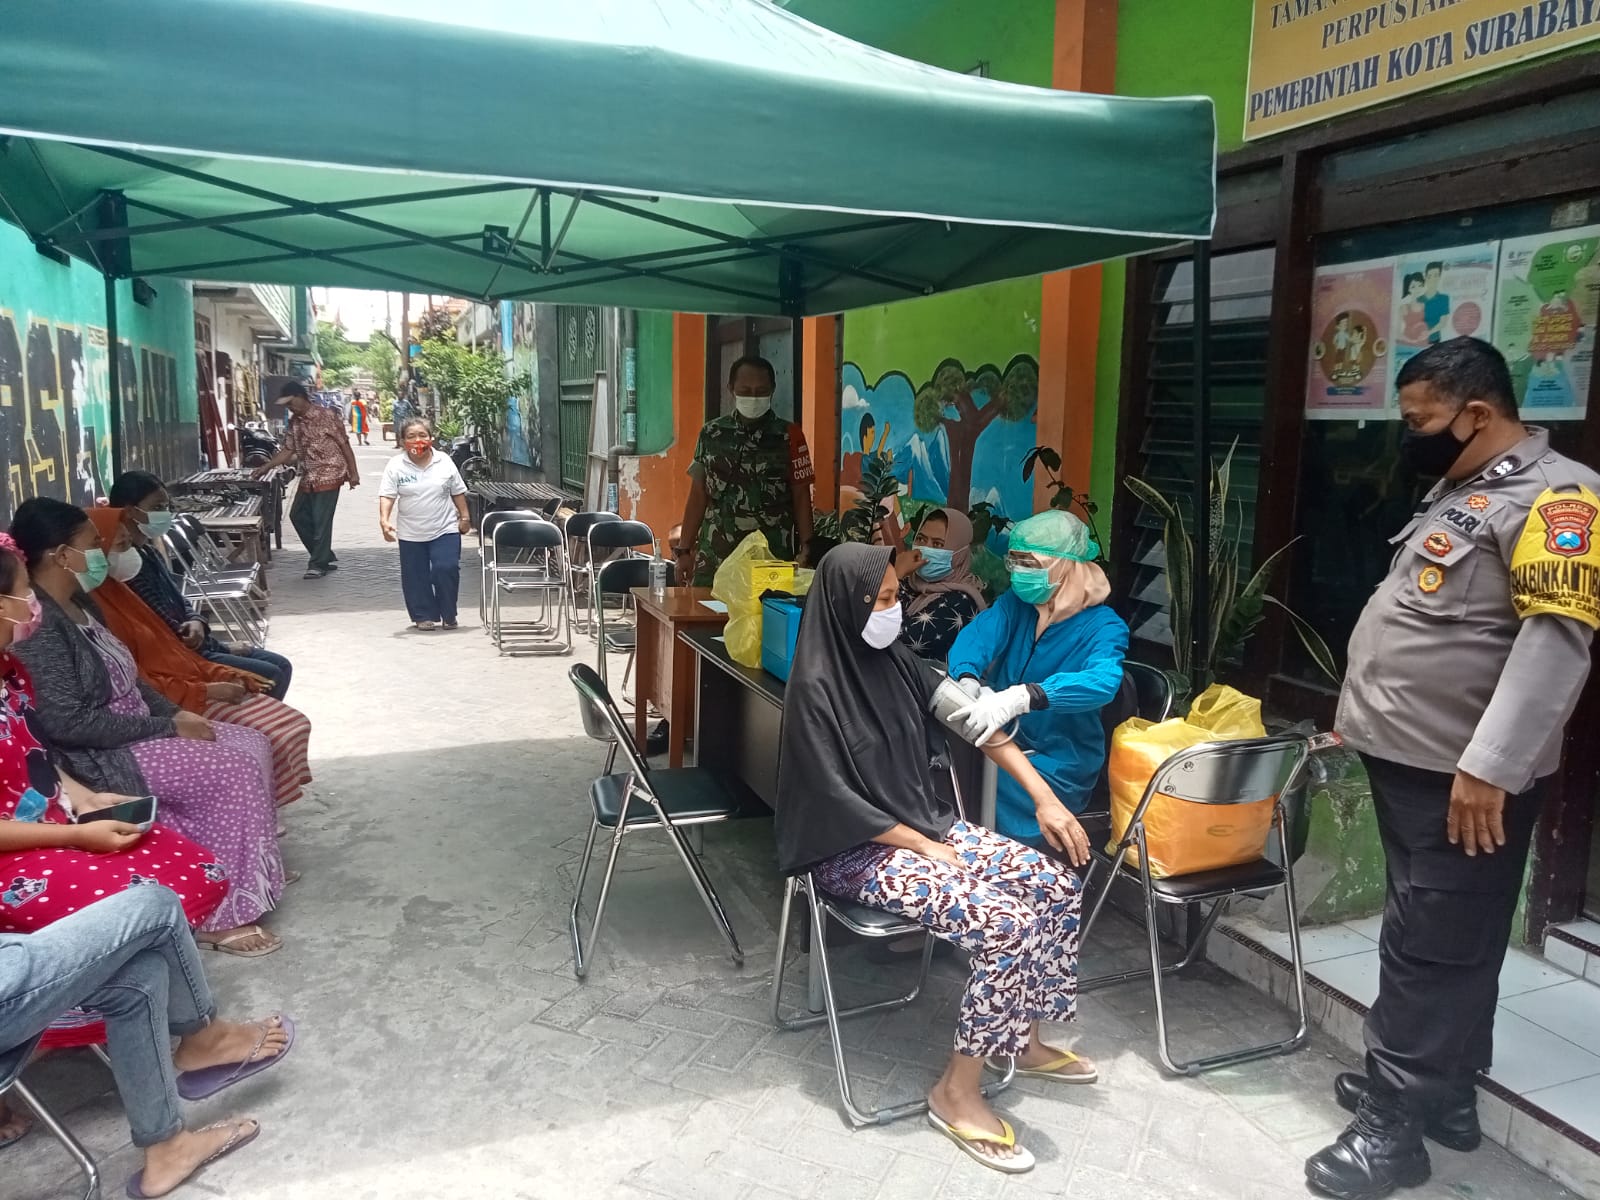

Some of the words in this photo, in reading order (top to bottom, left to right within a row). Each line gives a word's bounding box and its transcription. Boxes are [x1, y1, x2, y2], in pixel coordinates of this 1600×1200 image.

[1271, 0, 1337, 28] TAMA
[1249, 54, 1381, 122] PEMERINTAH
[1386, 31, 1454, 83] KOTA
[1463, 0, 1600, 60] SURABAY
[1440, 508, 1481, 533] POLRI
